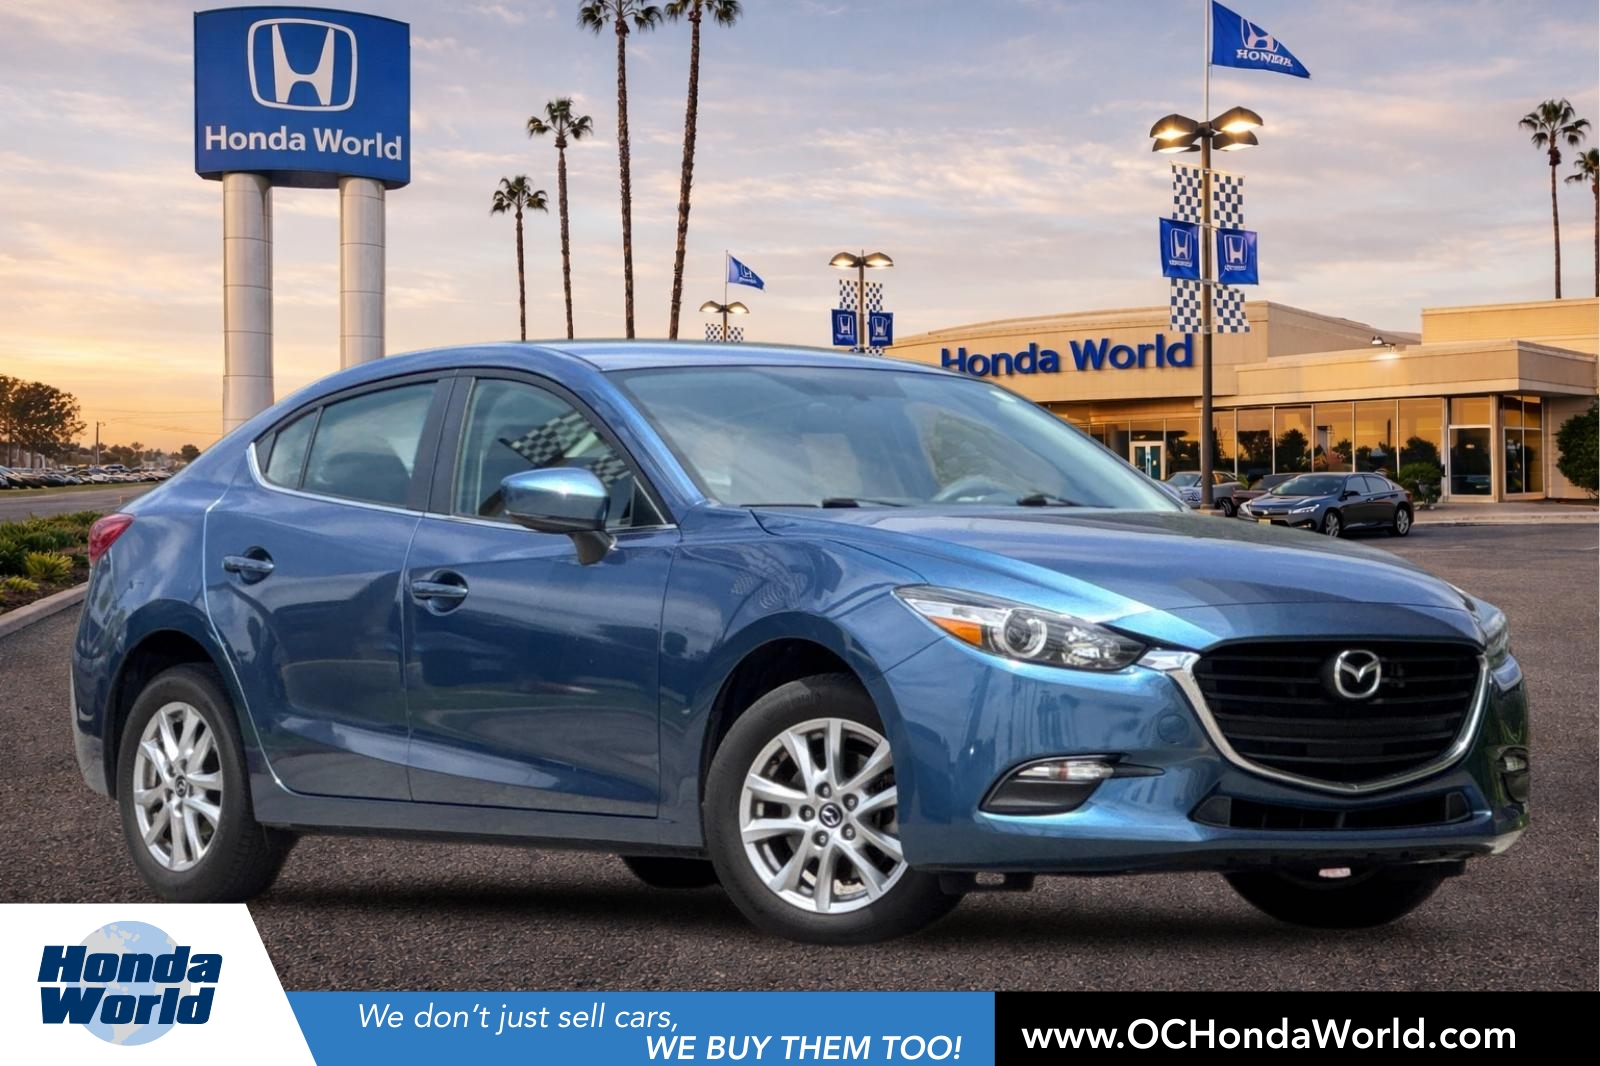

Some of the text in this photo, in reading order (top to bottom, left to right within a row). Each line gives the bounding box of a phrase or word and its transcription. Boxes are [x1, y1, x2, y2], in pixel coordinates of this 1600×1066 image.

[205, 125, 402, 161] Honda World
[941, 333, 1194, 377] Honda World
